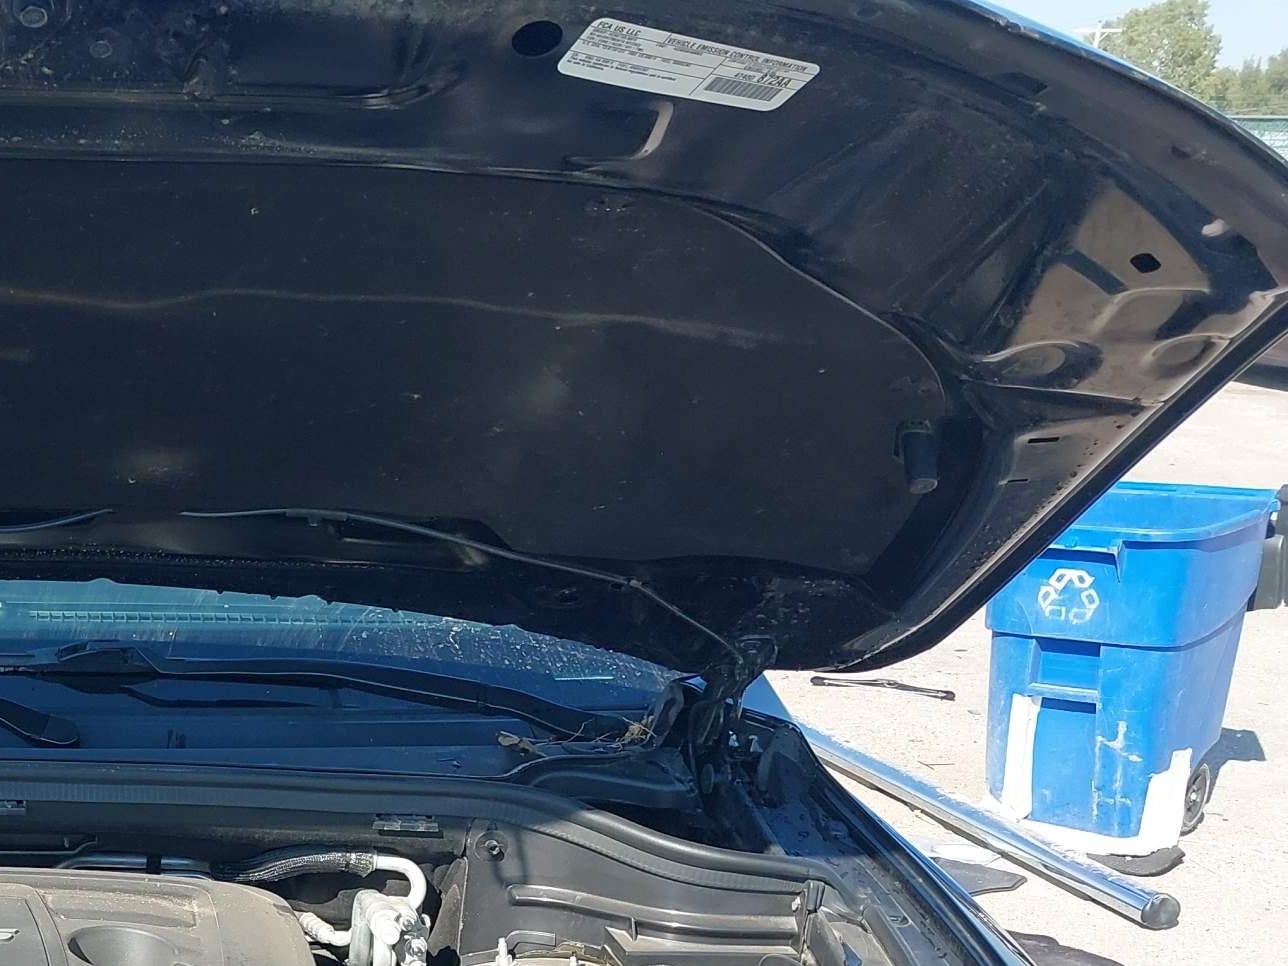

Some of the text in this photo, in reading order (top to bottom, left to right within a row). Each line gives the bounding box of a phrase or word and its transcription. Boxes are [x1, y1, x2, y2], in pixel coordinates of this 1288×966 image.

[596, 21, 613, 29] FCA
[625, 28, 642, 36] LLC
[667, 38, 695, 48] VEHICLE
[696, 44, 729, 55] EMISSION
[729, 51, 760, 62] CONTROL
[761, 58, 808, 72] INFORMATION
